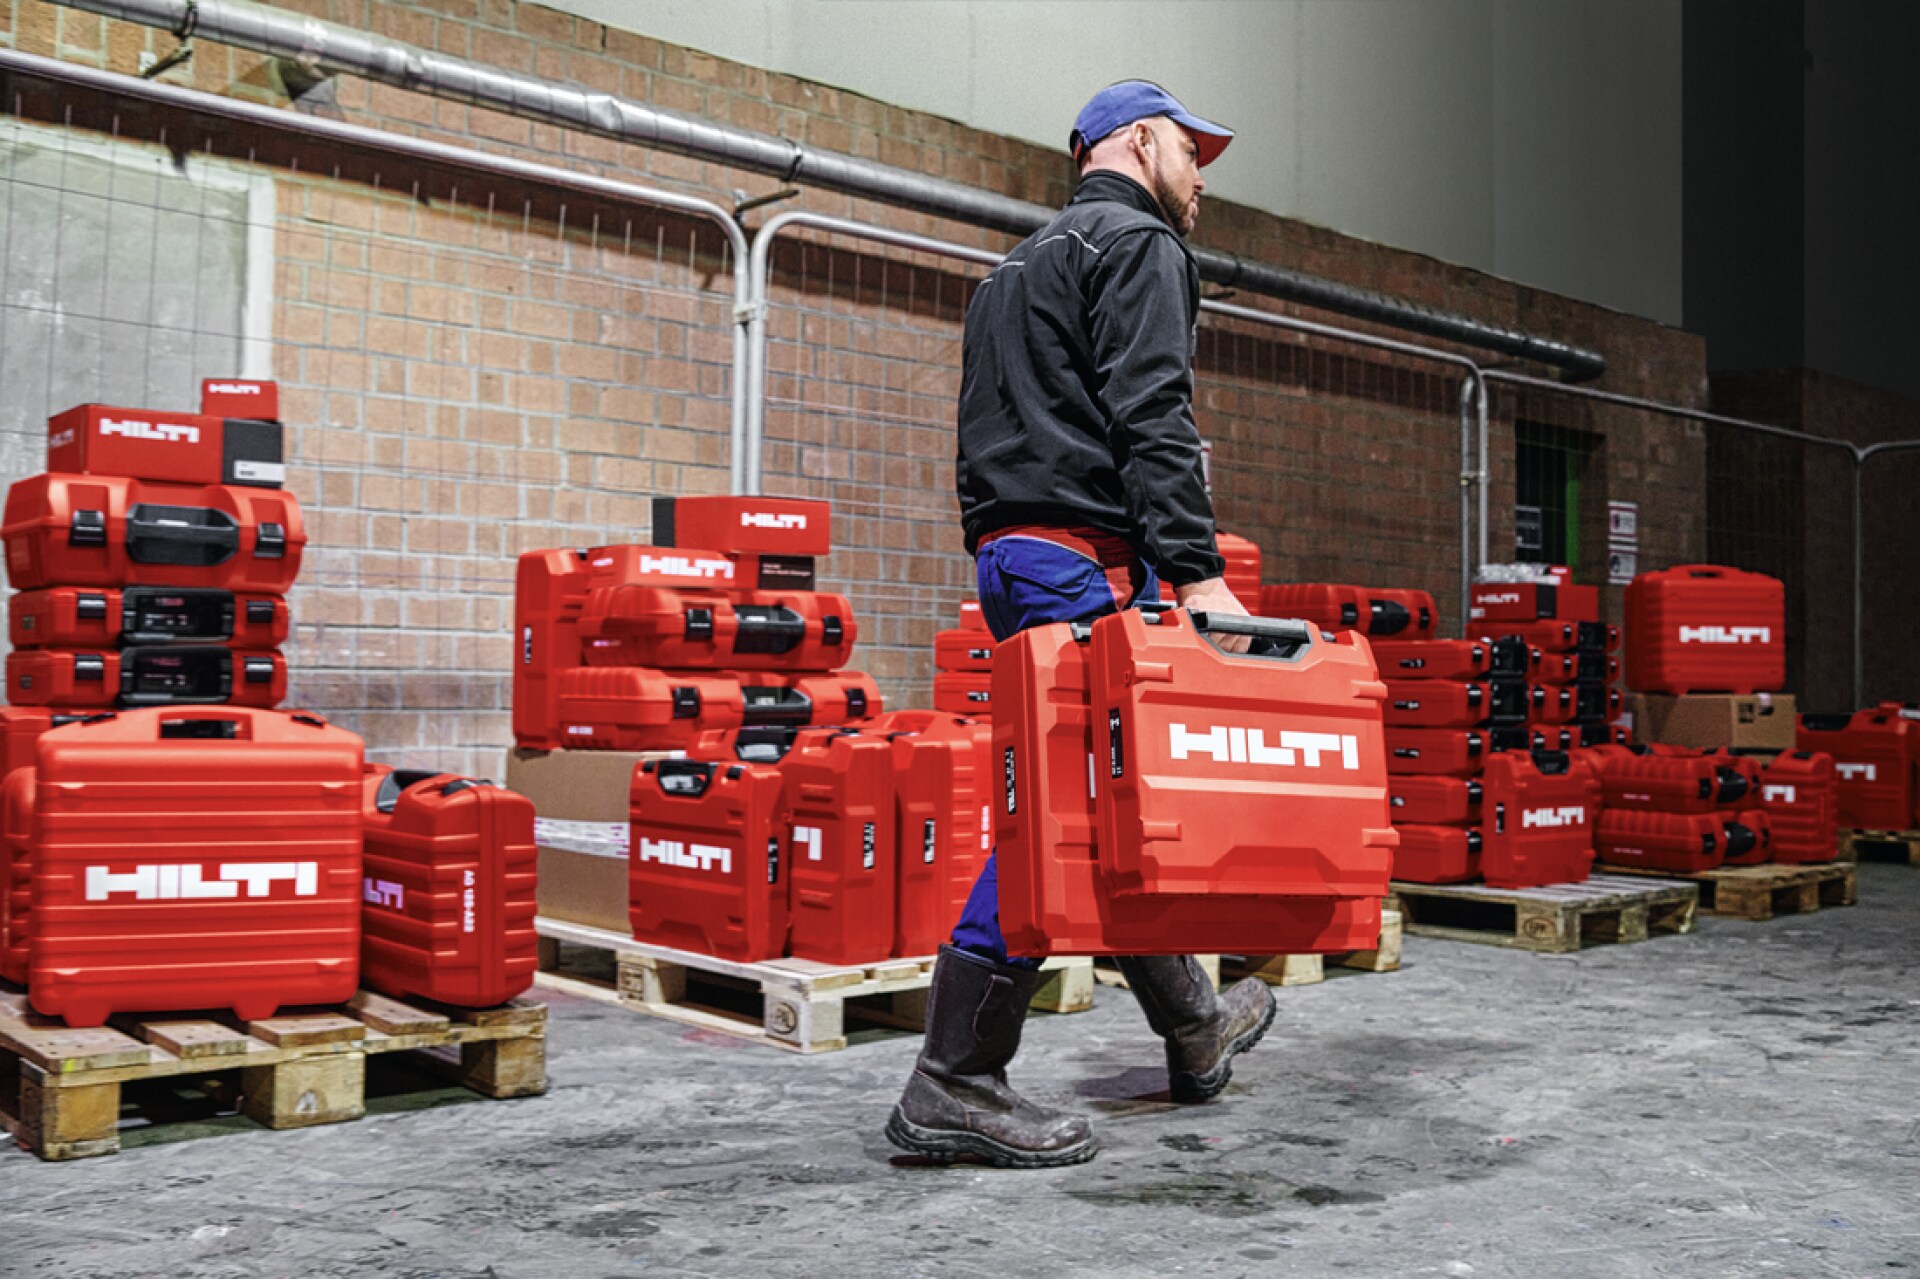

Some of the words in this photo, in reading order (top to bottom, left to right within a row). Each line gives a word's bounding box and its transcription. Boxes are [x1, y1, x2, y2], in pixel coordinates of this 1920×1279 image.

[208, 383, 260, 395] HILTI
[99, 417, 200, 443] HILTI
[741, 512, 807, 529] HILTI
[639, 554, 734, 579] HILTI
[1476, 592, 1520, 604] HILTI
[1678, 625, 1770, 643] HILTI
[1169, 723, 1359, 770] HILTI
[1522, 806, 1584, 828] HILTI
[640, 837, 732, 873] HILTI
[85, 861, 318, 901] HILTI
